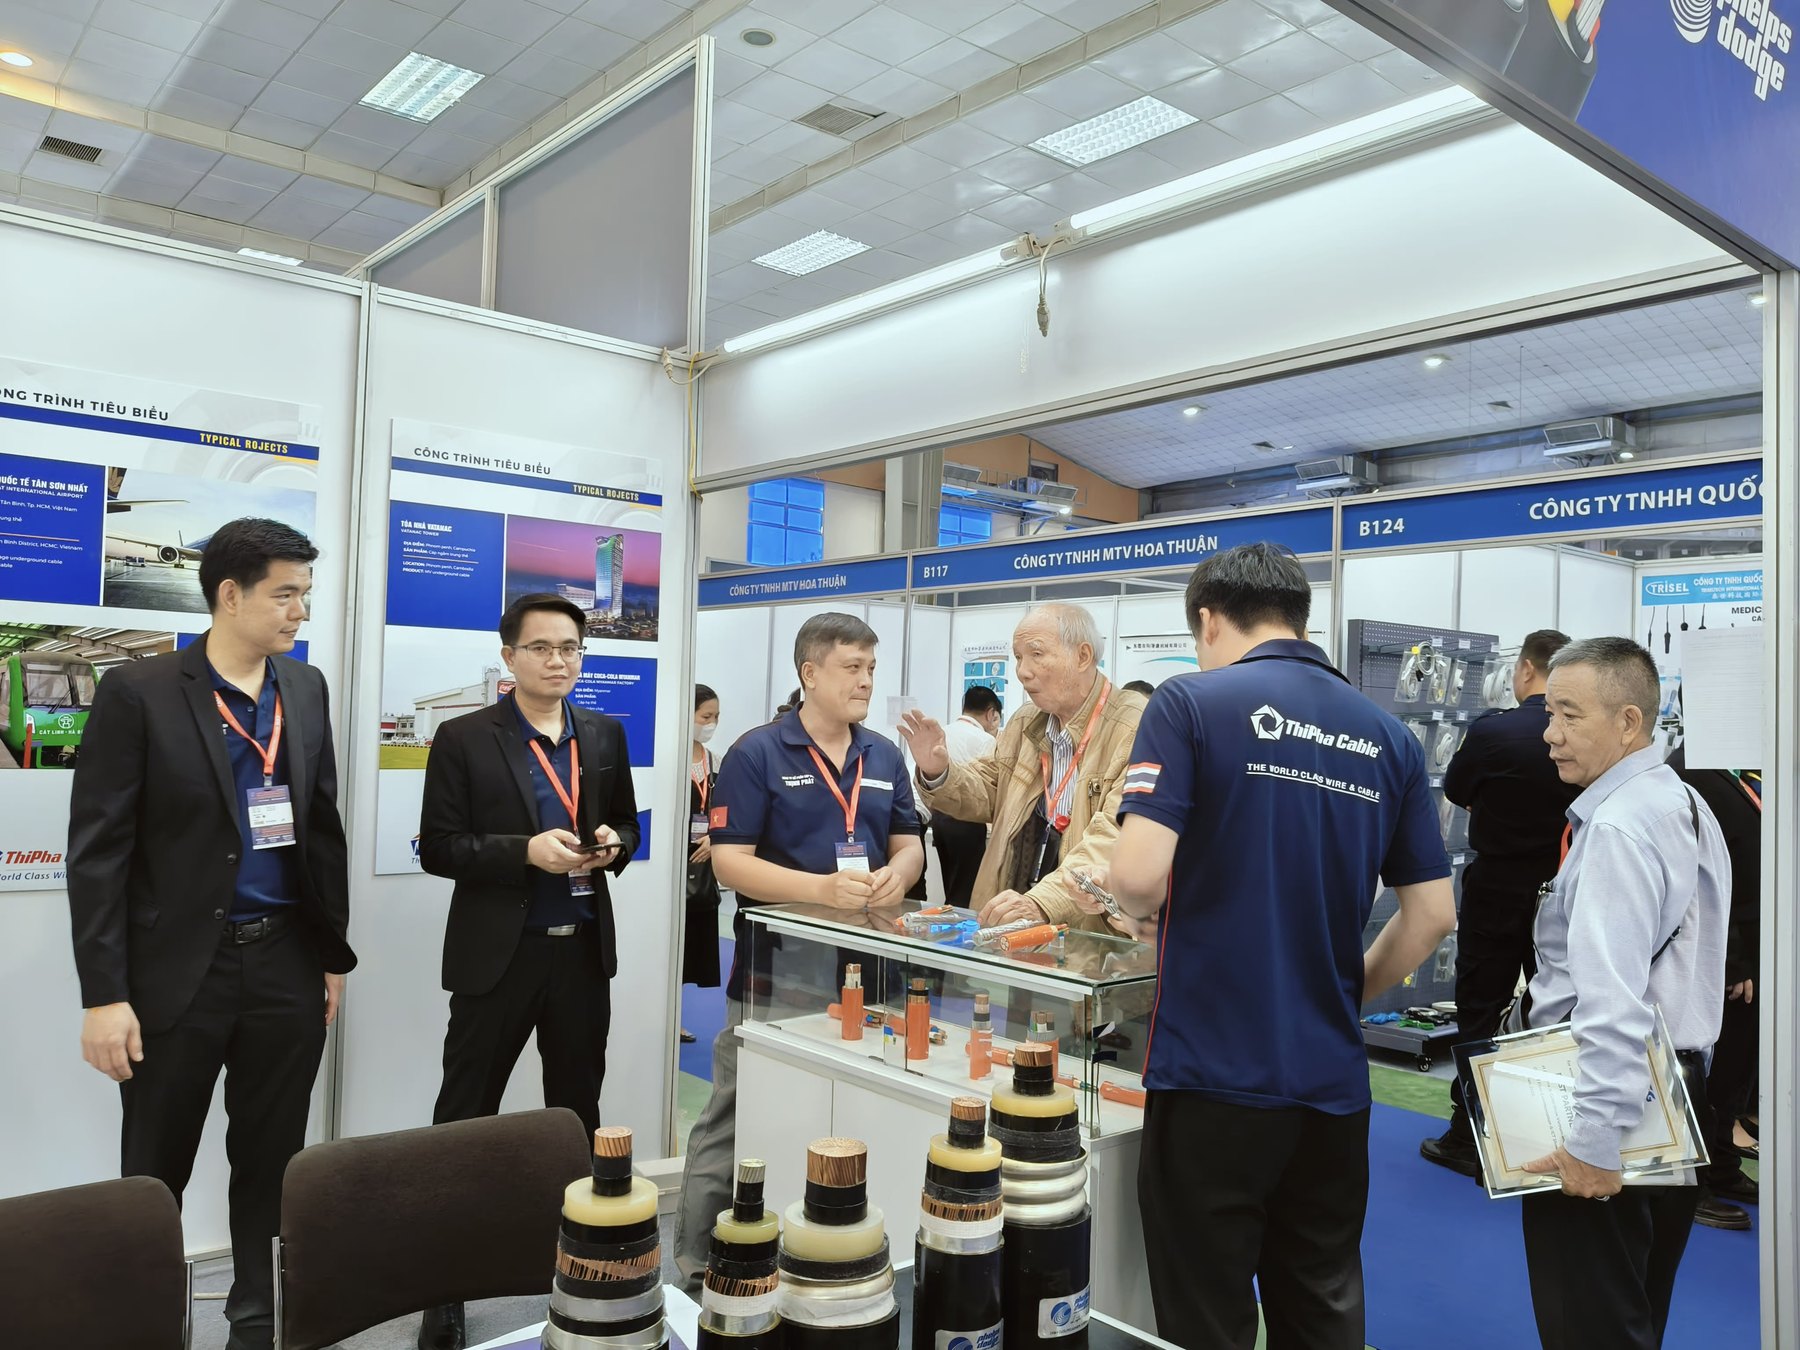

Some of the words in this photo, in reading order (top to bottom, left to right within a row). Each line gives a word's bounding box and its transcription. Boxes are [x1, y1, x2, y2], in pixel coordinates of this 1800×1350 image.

[1717, 0, 1792, 54] elps
[1717, 9, 1785, 101] dodge
[0, 387, 27, 400] NG
[33, 392, 84, 409] TRÌNH
[90, 401, 126, 415] TIÊU
[132, 405, 169, 421] BIỂU
[200, 433, 241, 448] TYPICAL
[245, 439, 288, 454] ROJECTS
[414, 447, 449, 460] CÔNG
[453, 452, 490, 467] TRÌNH
[494, 458, 520, 471] TIÊU
[524, 461, 551, 475] BIỂU
[0, 474, 18, 485] UỐC
[20, 476, 30, 487] TẾ
[31, 478, 47, 489] TÂN
[49, 481, 66, 491] SƠN
[68, 482, 88, 493] NHẤT
[6, 485, 55, 496] INTERNATIONAL
[572, 484, 604, 497] TYPICAL
[606, 489, 640, 501] ROJECTS
[1529, 497, 1591, 520] CÔNG
[1594, 494, 1622, 514] TY
[1625, 487, 1693, 511] TNHH
[1698, 474, 1763, 506] QUỐ
[1358, 517, 1405, 537] B124
[10, 555, 47, 563] underground
[1013, 554, 1047, 570] CÔNG
[1048, 552, 1063, 566] TY
[1065, 549, 1100, 564] TNHH
[1102, 545, 1132, 561] MTV
[1134, 542, 1164, 558] HOA
[1166, 534, 1218, 555] THUẬN
[923, 565, 949, 579] B117
[1715, 577, 1723, 585] TY
[1724, 576, 1742, 585] TNHH
[729, 583, 750, 597] CÔNG
[750, 584, 760, 595] TY
[760, 582, 781, 594] TNHH
[781, 580, 799, 592] MTV
[799, 578, 817, 590] HOA
[817, 573, 847, 589] THUẬN
[1285, 718, 1336, 747] ThiPha
[1335, 733, 1379, 759] Cable
[1246, 762, 1267, 772] THE
[1325, 777, 1347, 790] WIRE
[1348, 783, 1355, 792] &
[1357, 785, 1380, 799] CABLE
[5, 850, 63, 864] ThiPha
[0, 872, 22, 881] orld
[24, 872, 50, 880] Class
[53, 871, 68, 879] Wi
